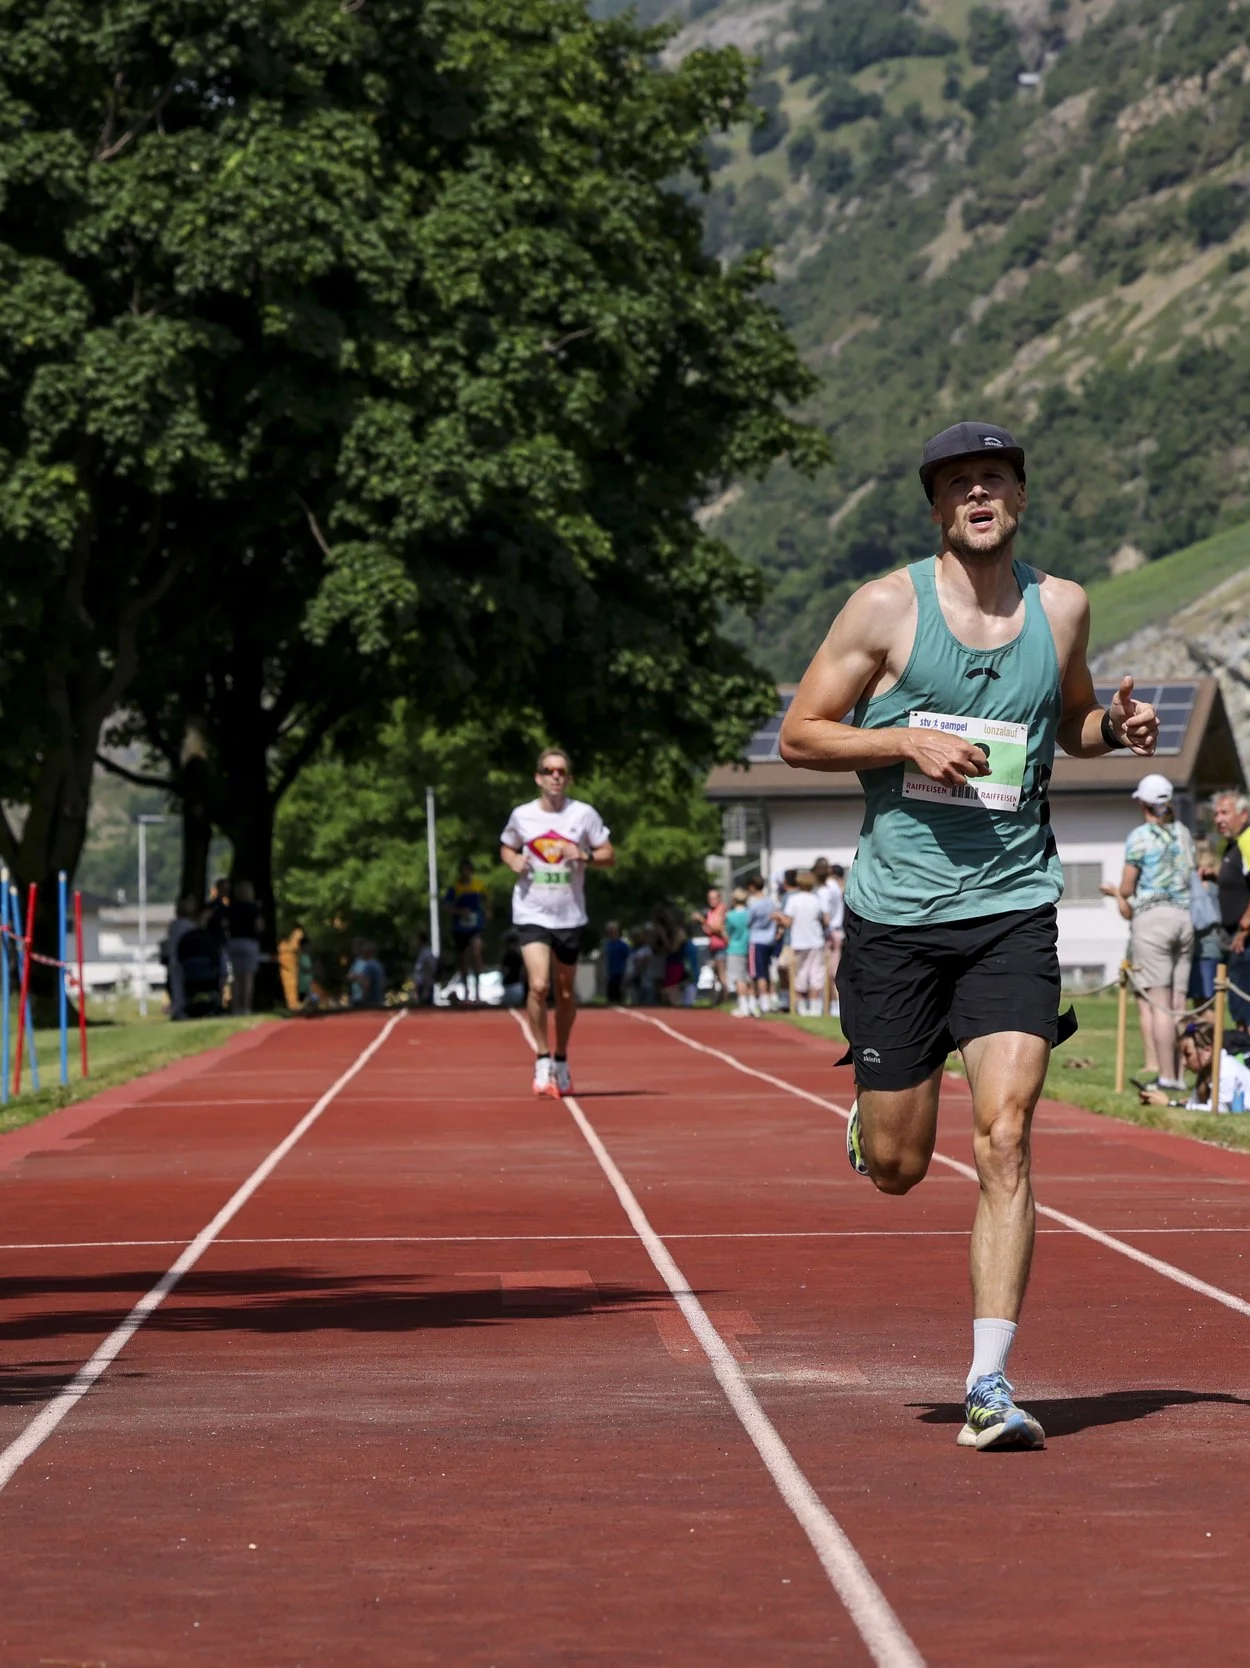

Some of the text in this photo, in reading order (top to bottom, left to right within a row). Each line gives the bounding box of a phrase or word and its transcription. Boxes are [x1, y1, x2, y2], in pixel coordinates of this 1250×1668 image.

[920, 718, 968, 732] stv gampel
[984, 724, 1018, 738] lonzalauf
[906, 782, 947, 794] RAIFFEISEN
[980, 791, 1017, 802] RAIFFEISEN
